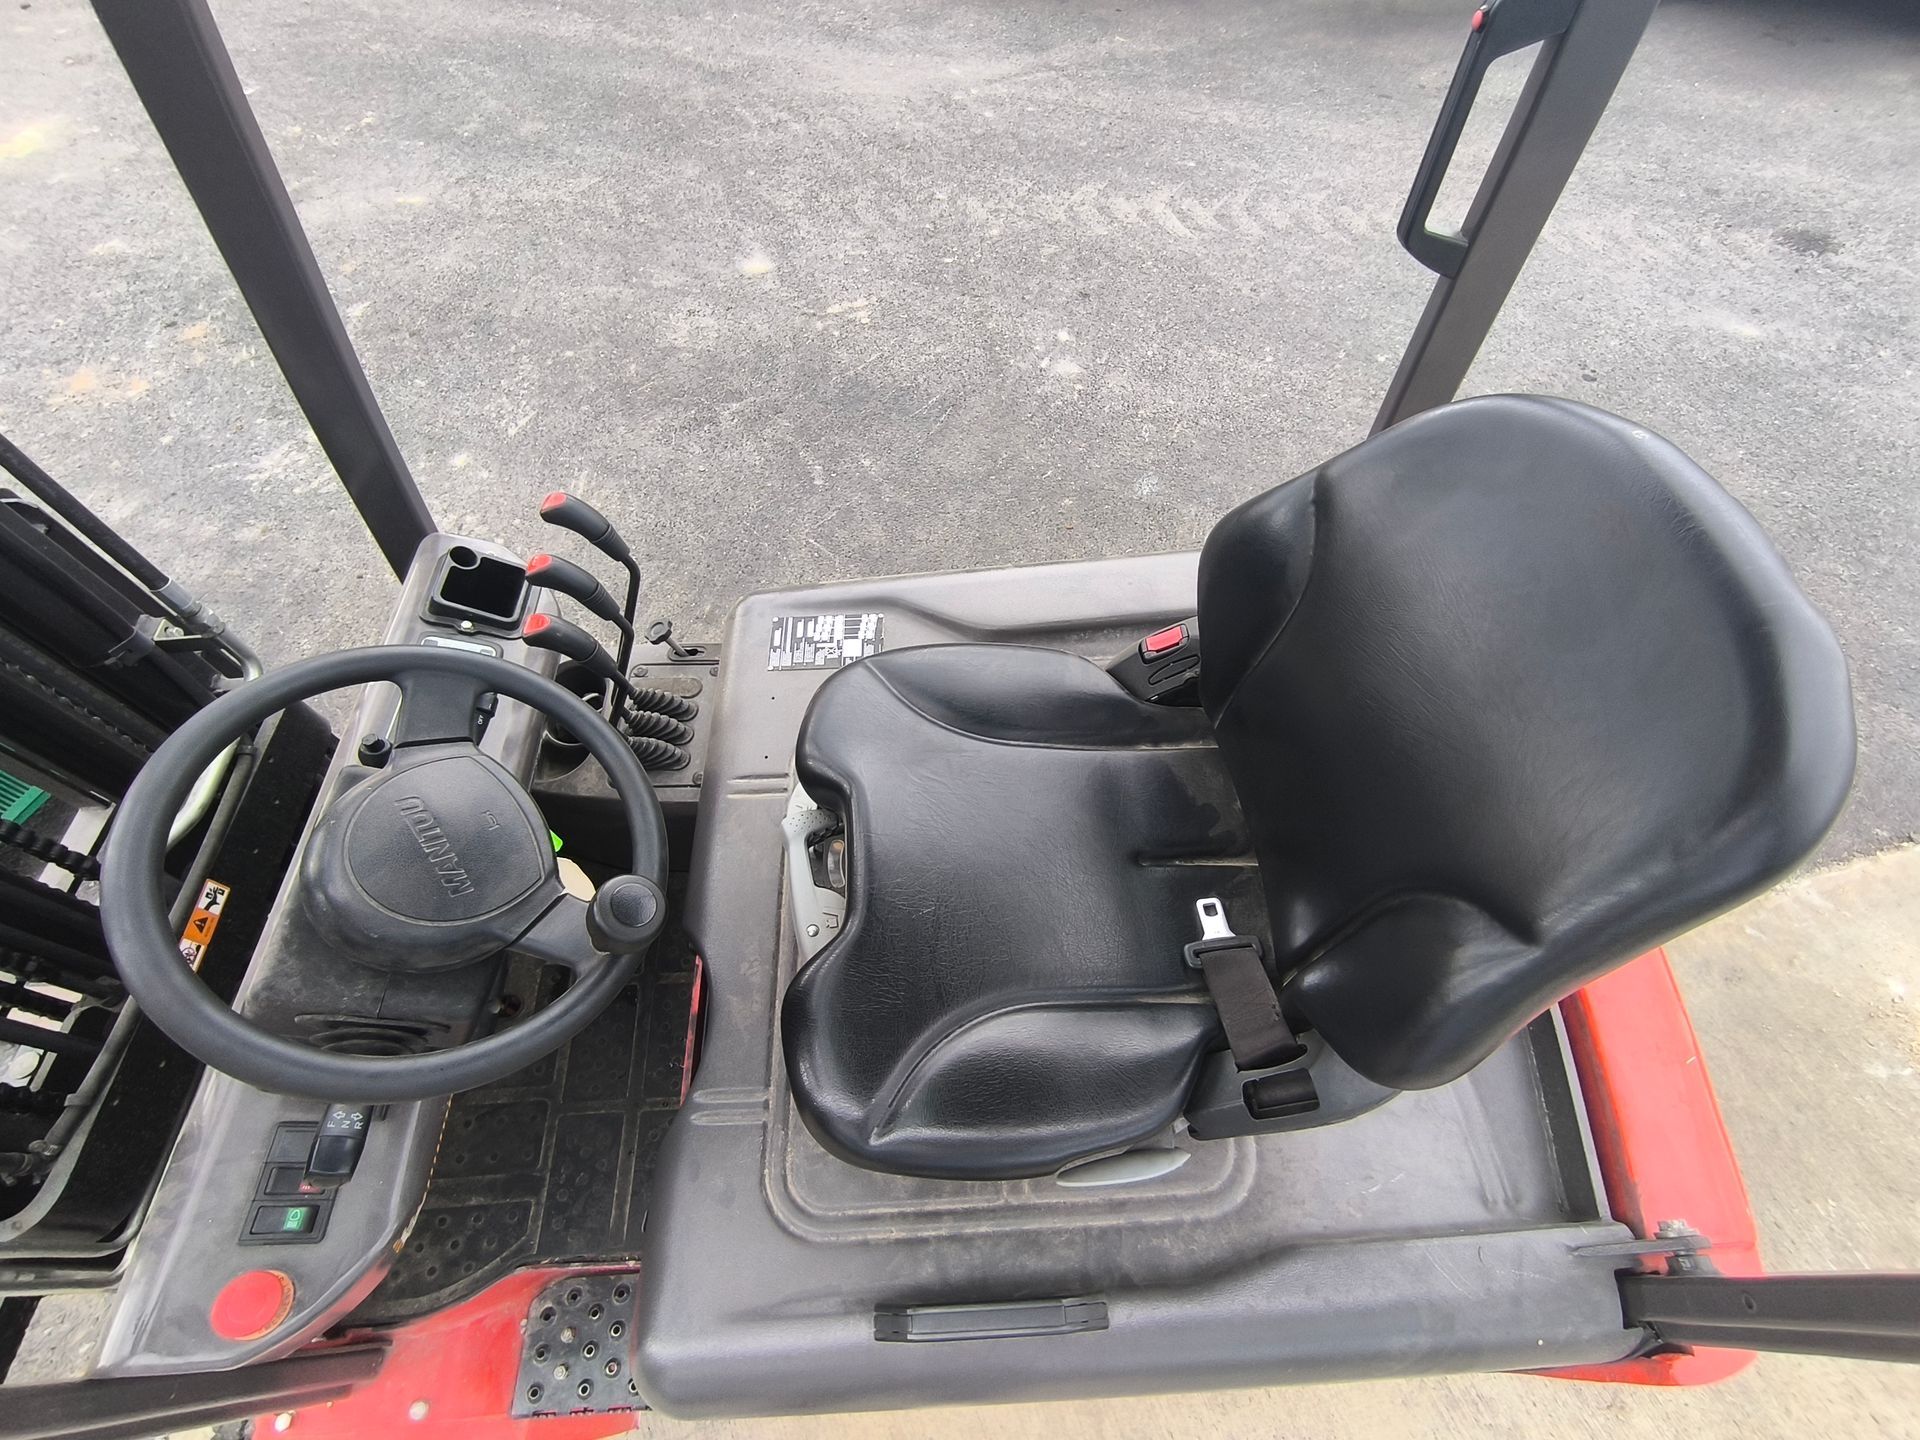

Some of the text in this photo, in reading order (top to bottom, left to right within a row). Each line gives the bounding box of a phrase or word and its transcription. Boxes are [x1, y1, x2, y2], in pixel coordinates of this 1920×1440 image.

[394, 794, 476, 898] MANITOU
[326, 1120, 364, 1130] F N R
